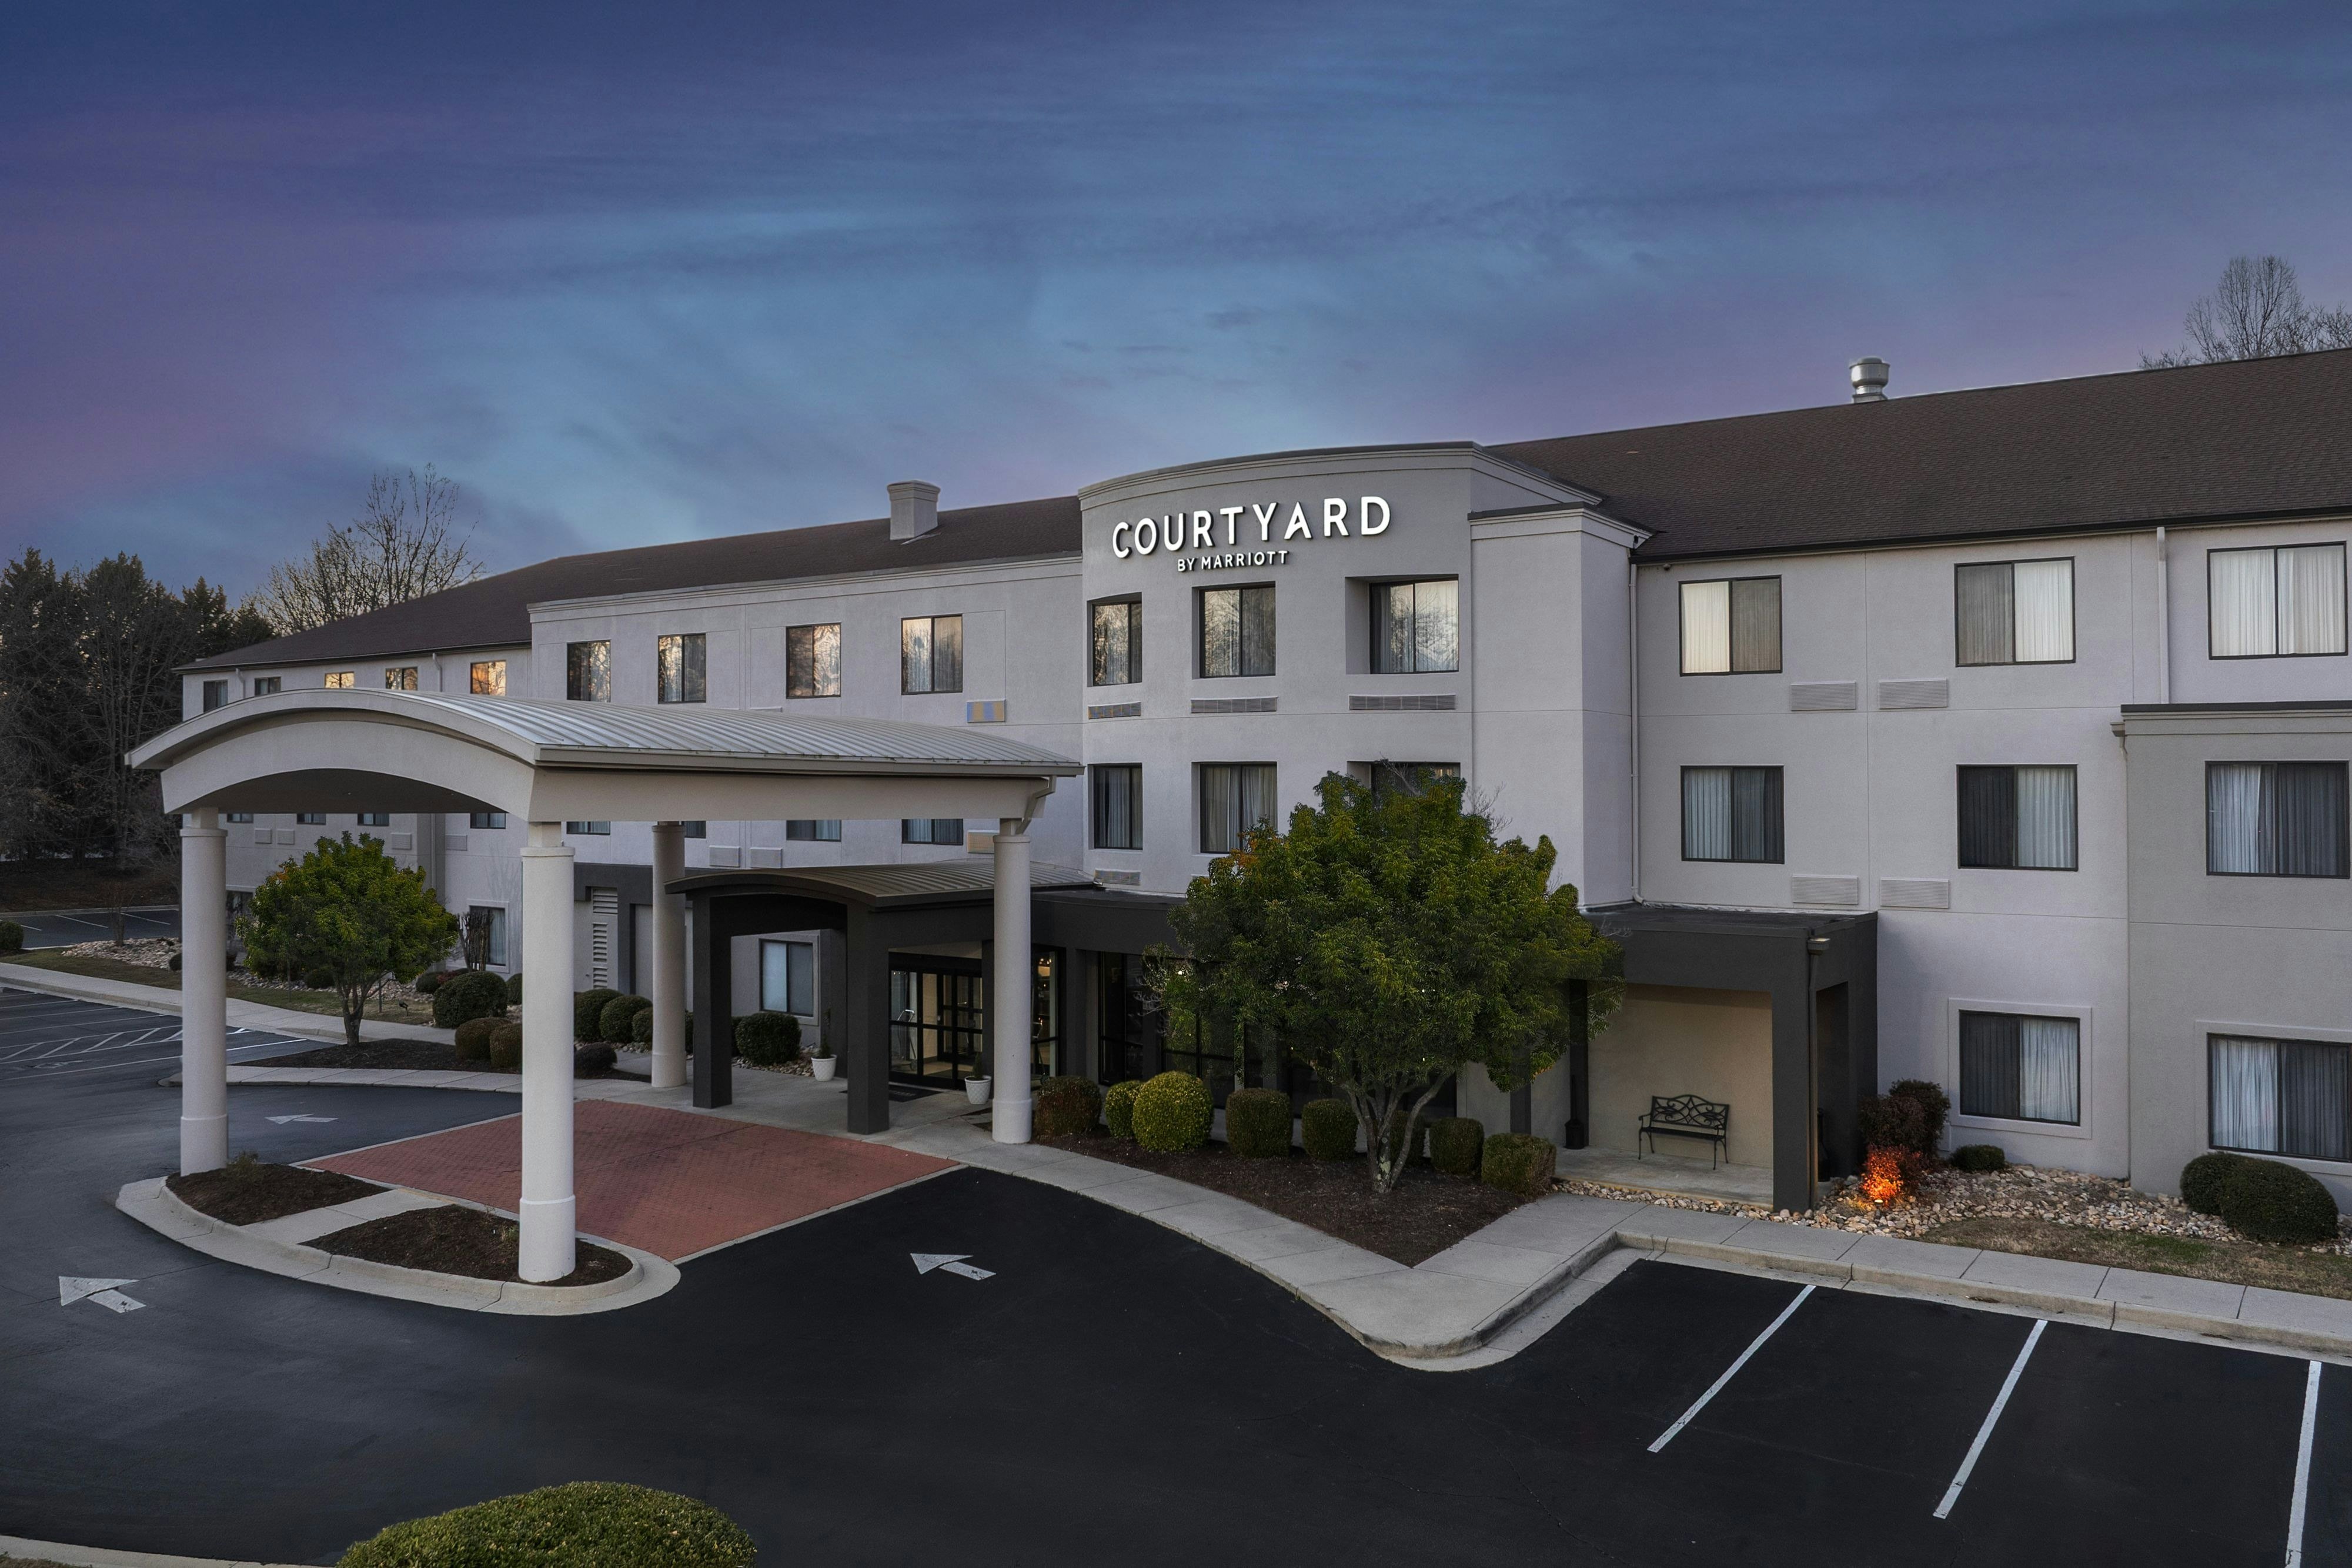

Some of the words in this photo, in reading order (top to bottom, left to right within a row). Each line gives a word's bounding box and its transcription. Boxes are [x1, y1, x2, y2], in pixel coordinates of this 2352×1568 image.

[1112, 496, 1391, 559] COURTYARD
[1178, 558, 1196, 572] BY
[1201, 550, 1289, 570] MARRIOTT
